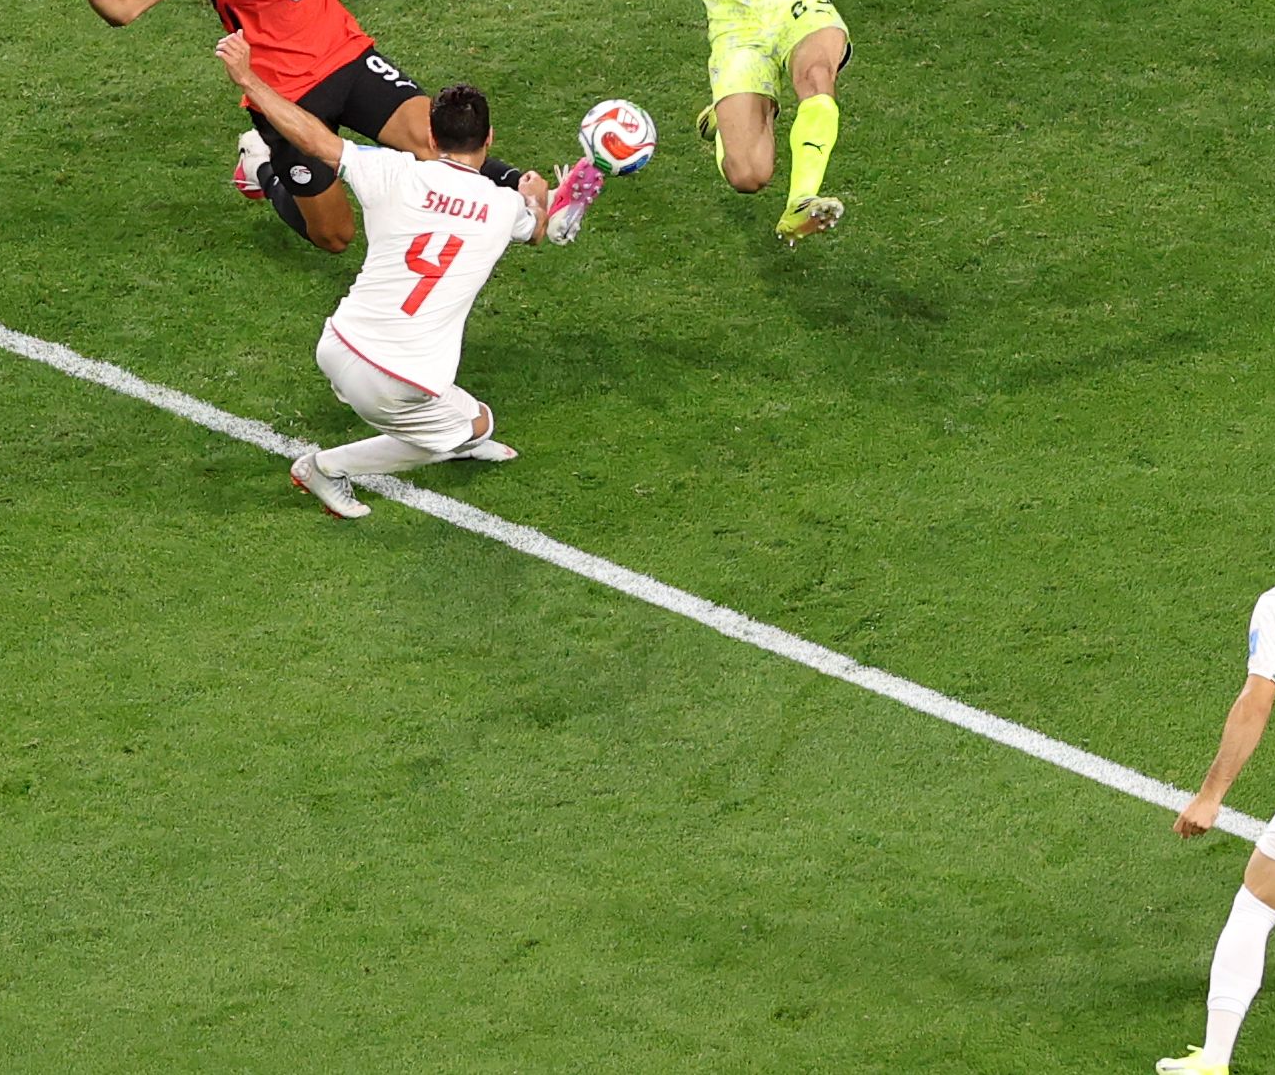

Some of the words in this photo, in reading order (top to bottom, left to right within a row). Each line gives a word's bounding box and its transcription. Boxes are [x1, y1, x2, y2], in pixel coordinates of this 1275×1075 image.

[365, 54, 400, 81] 9
[421, 190, 490, 224] SHOJA
[400, 231, 465, 317] 4
